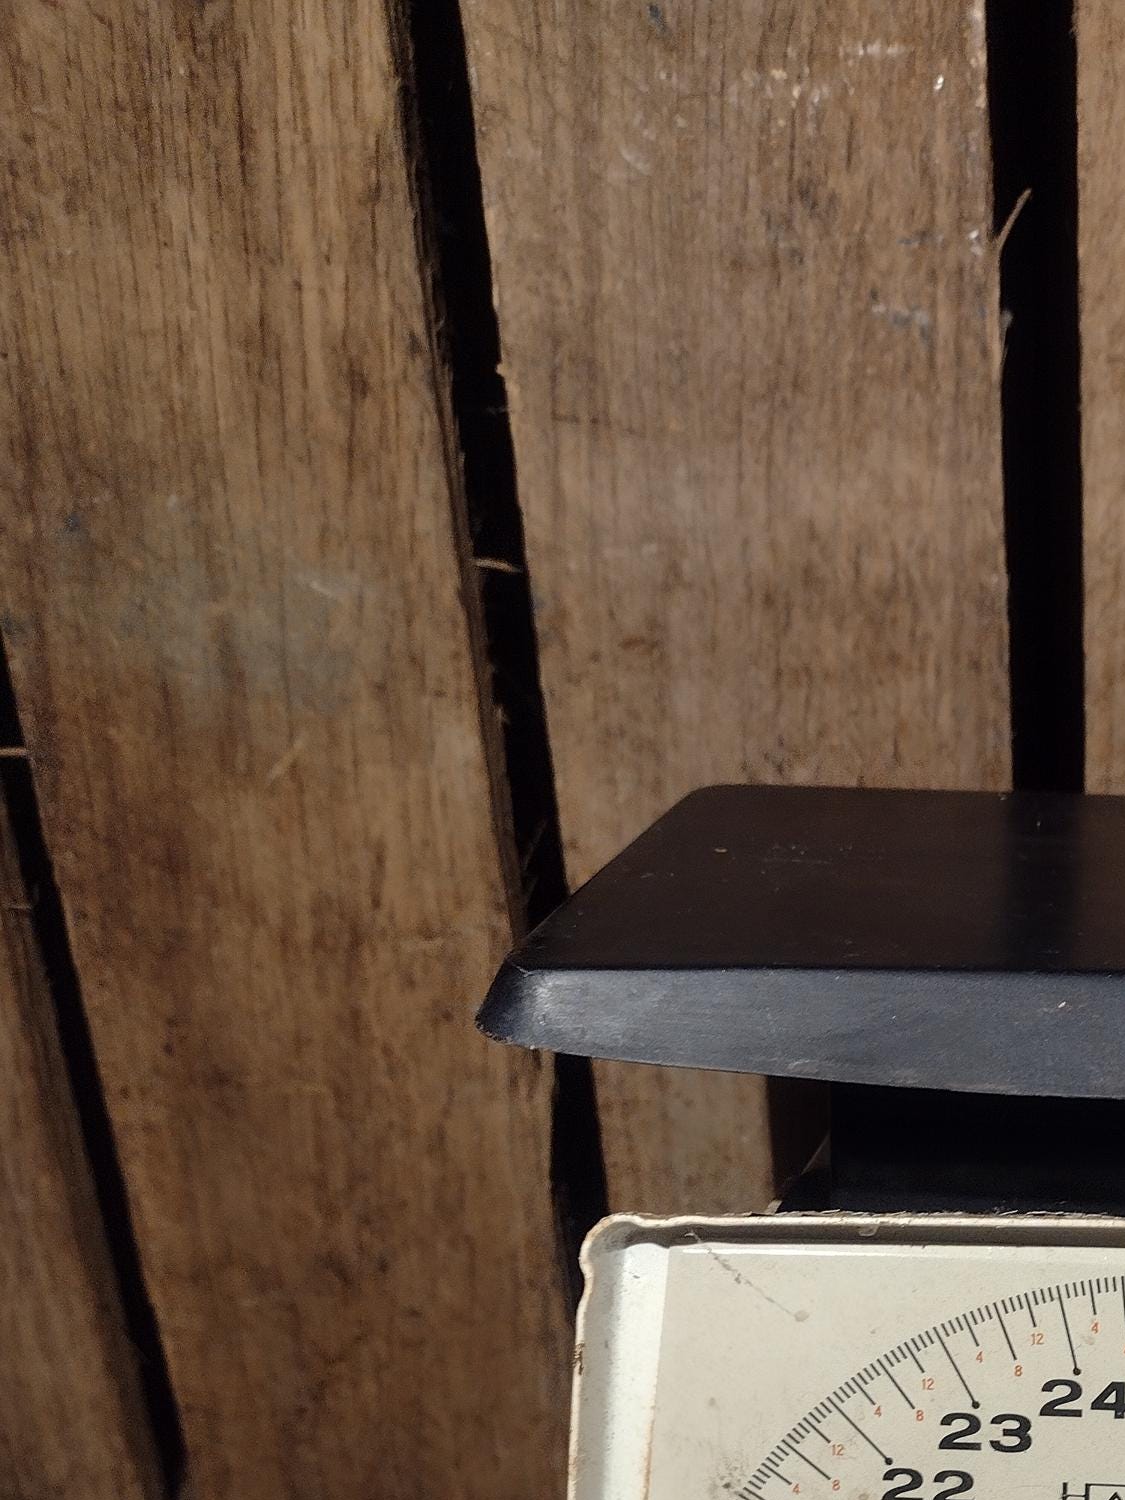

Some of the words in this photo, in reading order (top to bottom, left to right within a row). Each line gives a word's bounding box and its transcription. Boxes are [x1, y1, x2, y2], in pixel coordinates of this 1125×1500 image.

[1091, 1322, 1099, 1334] 4
[1031, 1333, 1044, 1346] 12
[976, 1351, 983, 1363] 4
[1014, 1365, 1023, 1377] 8
[922, 1378, 934, 1390] 12
[874, 1405, 882, 1417] 4
[916, 1410, 924, 1421] 8
[939, 1413, 1031, 1452] 23
[832, 1444, 845, 1456] 12
[792, 1484, 800, 1495] 4
[832, 1480, 840, 1491] 8
